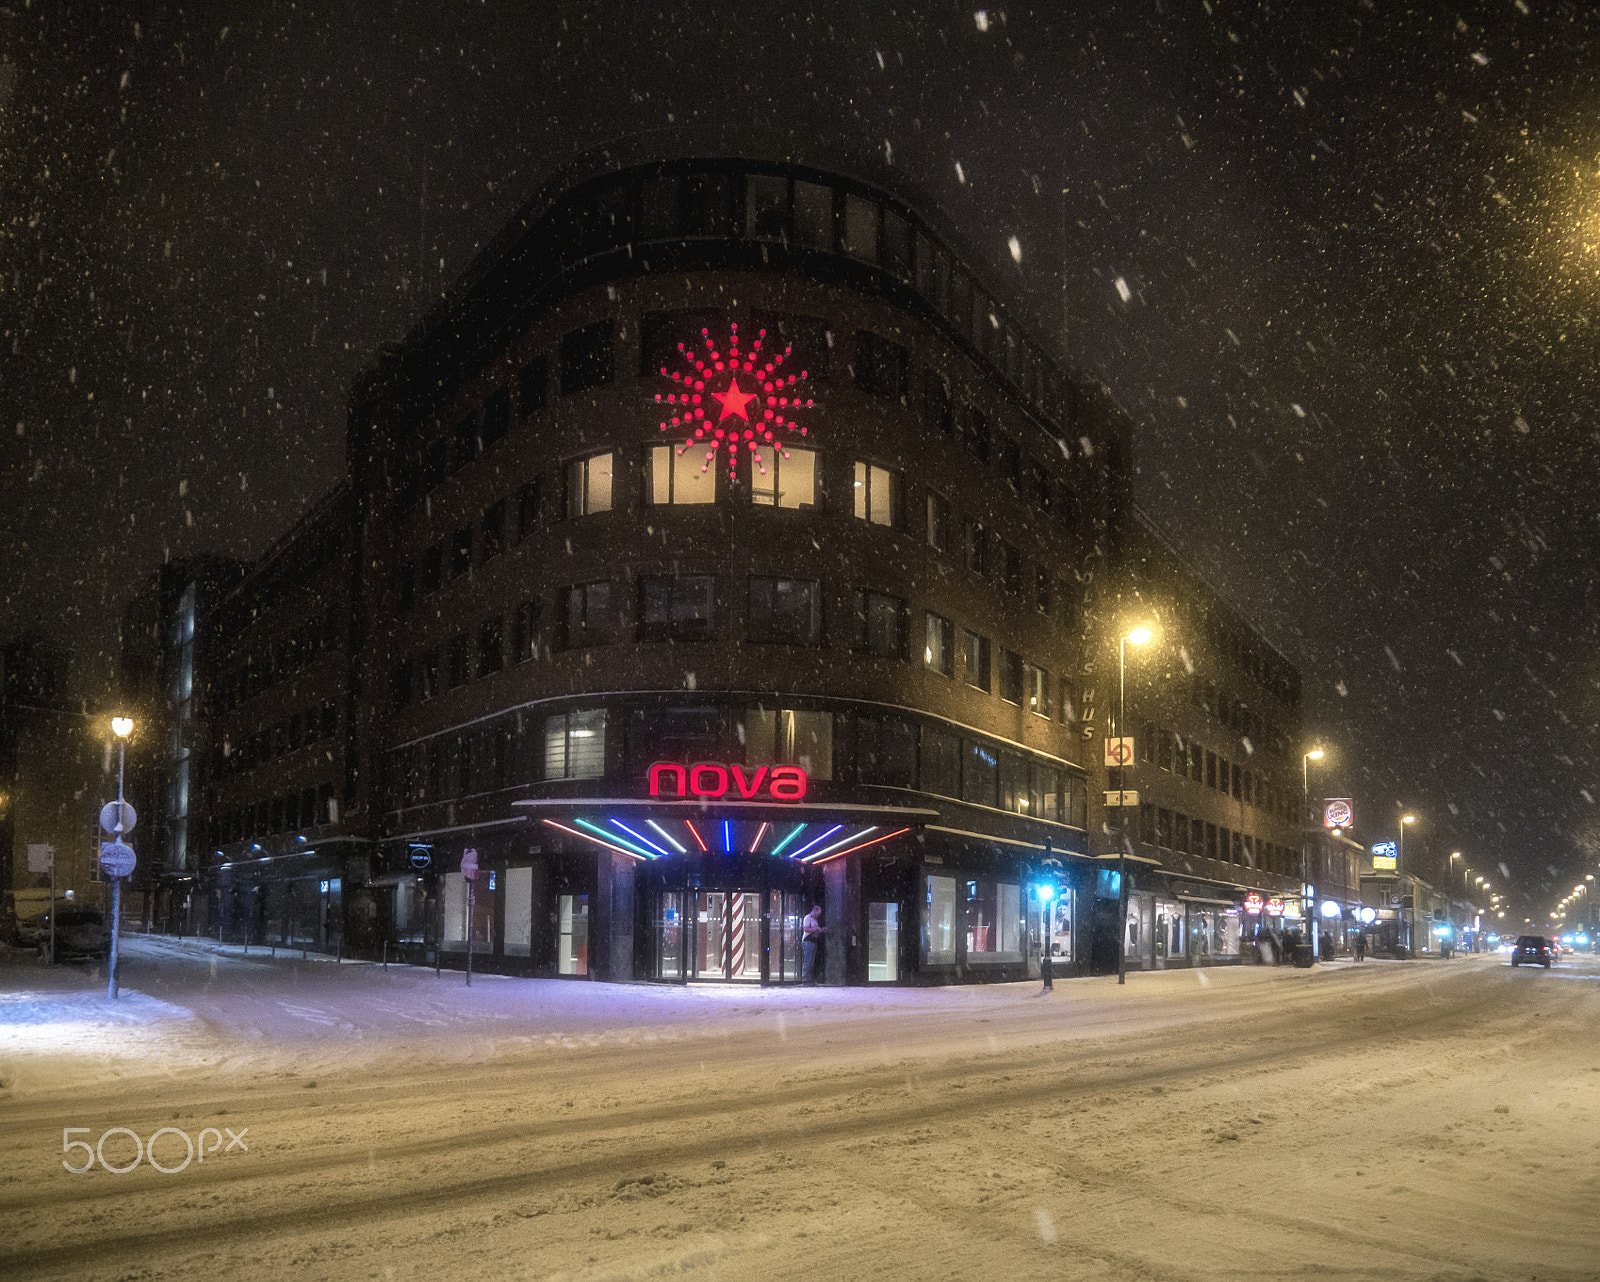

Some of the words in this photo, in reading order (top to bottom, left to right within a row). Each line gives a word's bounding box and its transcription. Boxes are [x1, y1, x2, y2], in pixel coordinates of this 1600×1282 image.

[1081, 687, 1096, 741] HUS
[649, 763, 807, 800] nova
[1330, 810, 1349, 818] KING
